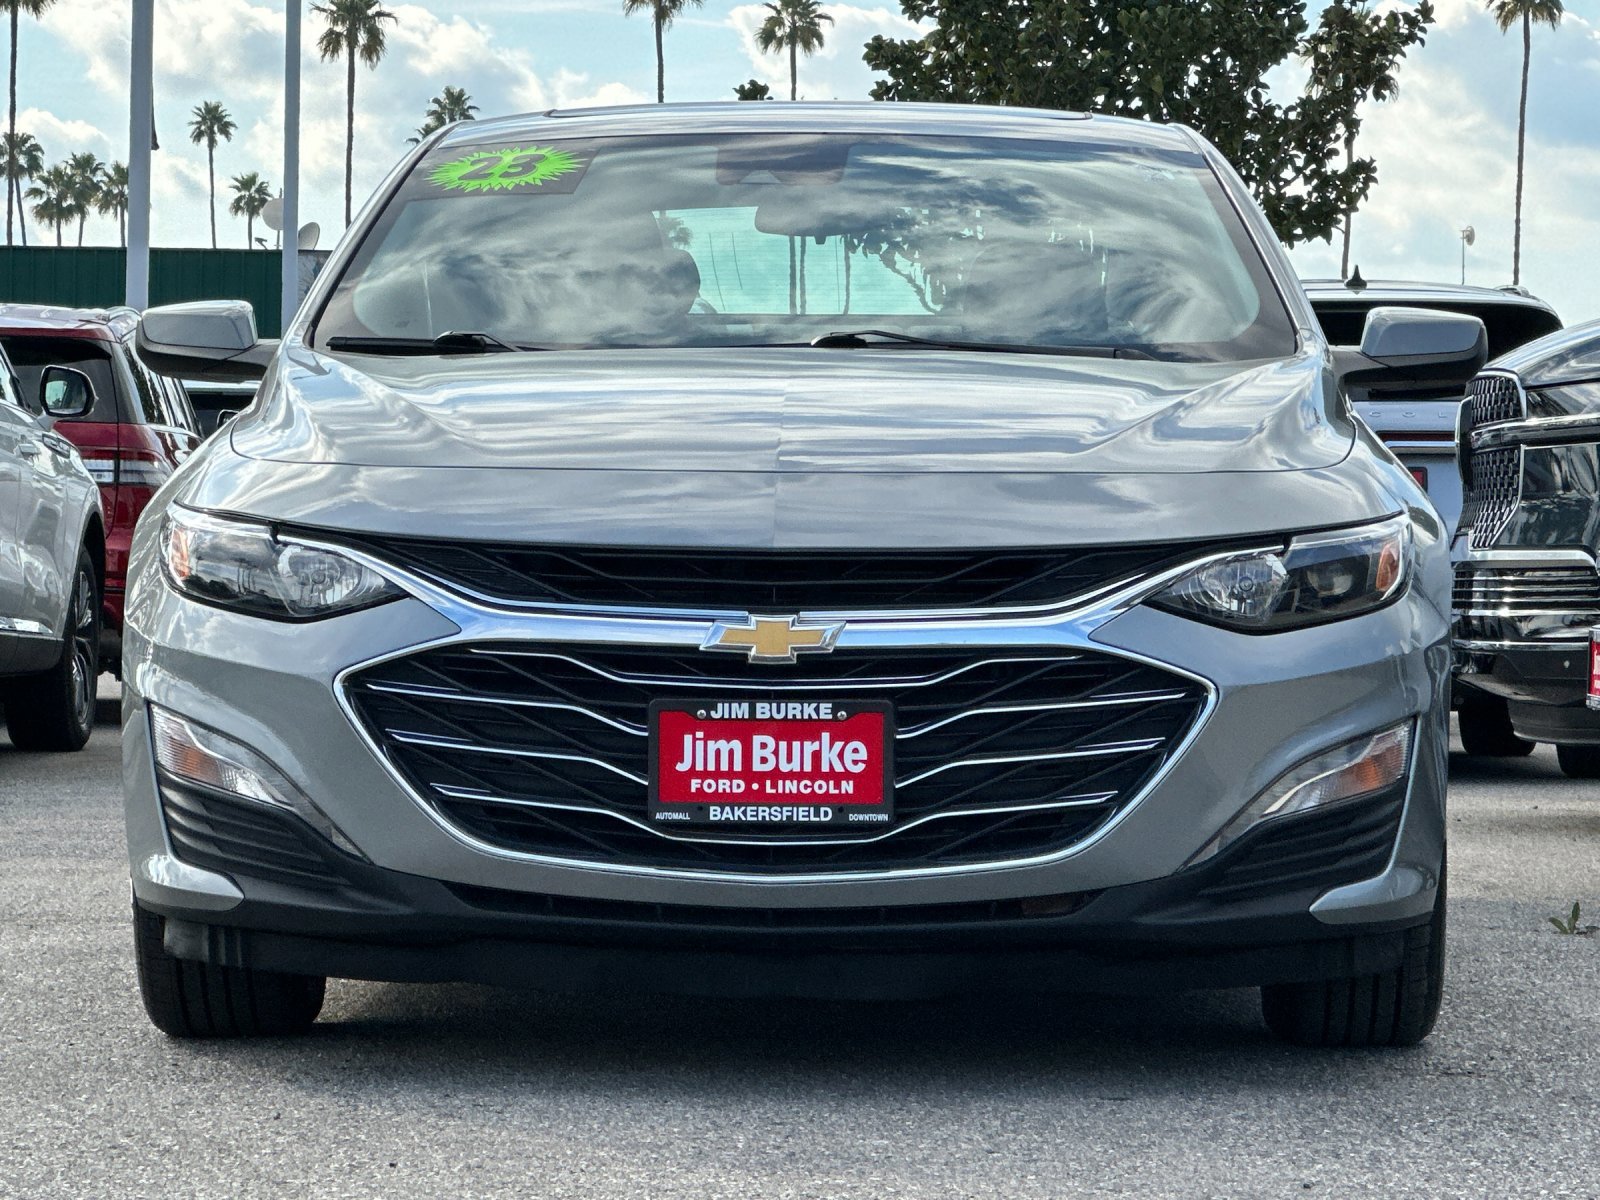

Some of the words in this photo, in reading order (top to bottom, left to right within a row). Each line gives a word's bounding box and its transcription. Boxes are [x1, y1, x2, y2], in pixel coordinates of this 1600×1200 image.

[458, 154, 548, 181] 23
[710, 702, 750, 719] JIM
[755, 702, 833, 720] BURKE
[675, 731, 743, 772] Jim
[752, 731, 868, 774] Burke
[690, 778, 746, 794] FORD
[765, 779, 854, 795] LINCOLN
[655, 812, 690, 820] AUTOMALL
[709, 806, 833, 822] BAKERSFIELD
